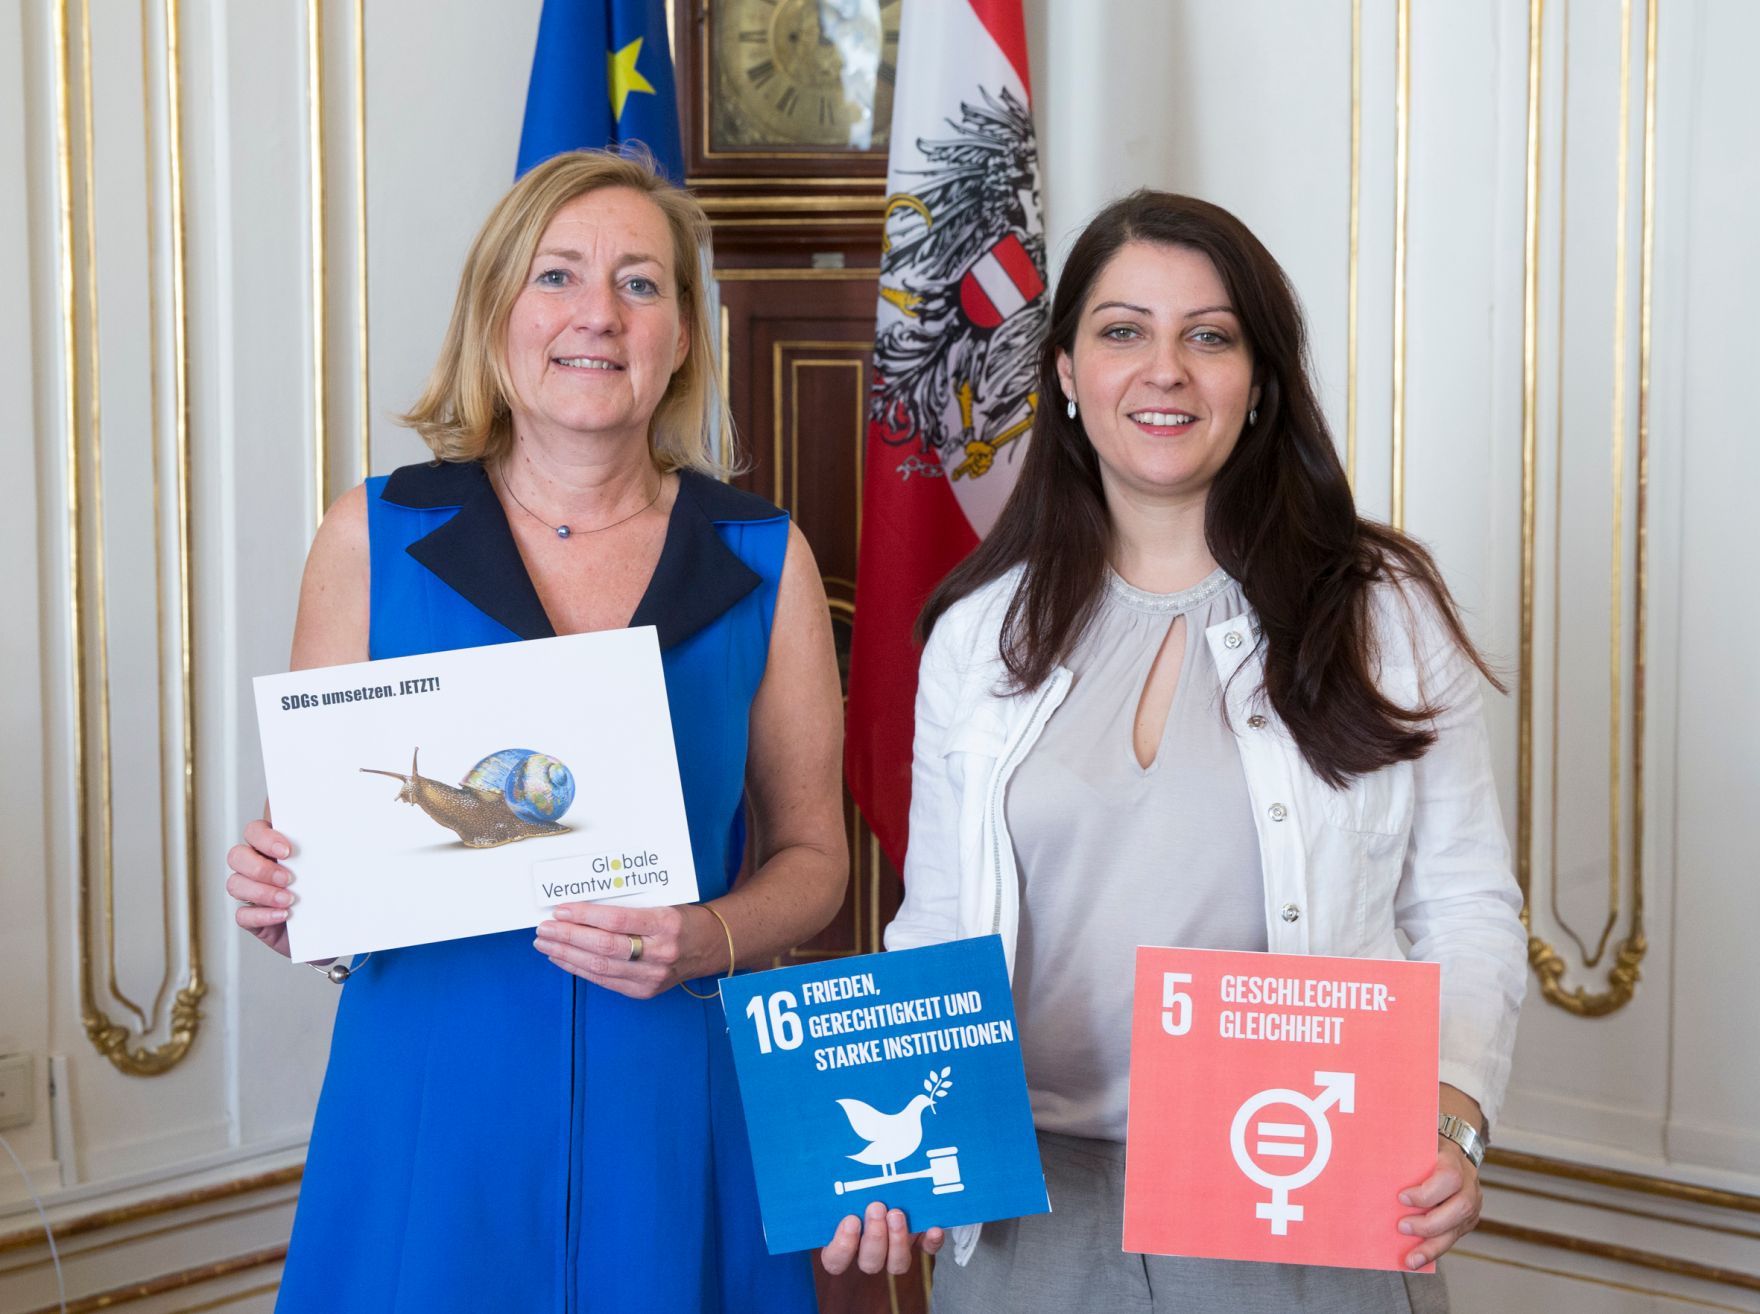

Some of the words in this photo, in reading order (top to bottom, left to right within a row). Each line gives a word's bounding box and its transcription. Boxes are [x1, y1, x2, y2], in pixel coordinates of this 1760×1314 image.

[281, 693, 319, 711] SDGs
[322, 684, 397, 706] umsetzen.
[399, 676, 441, 696] JETZT!
[592, 850, 659, 873] Globale
[542, 869, 669, 898] Verantwortung
[802, 973, 881, 1005] FRIEDEN,
[1161, 972, 1193, 1036] 5
[1220, 975, 1396, 1011] GESCHLECHTER-
[746, 991, 804, 1054] 16
[808, 996, 941, 1038] GERECHTIGKEIT
[944, 991, 982, 1017] UND
[1219, 1010, 1344, 1045] GLEICHHEIT
[814, 1040, 881, 1071] STARKE
[882, 1019, 1014, 1060] INSTITUTIONEN
